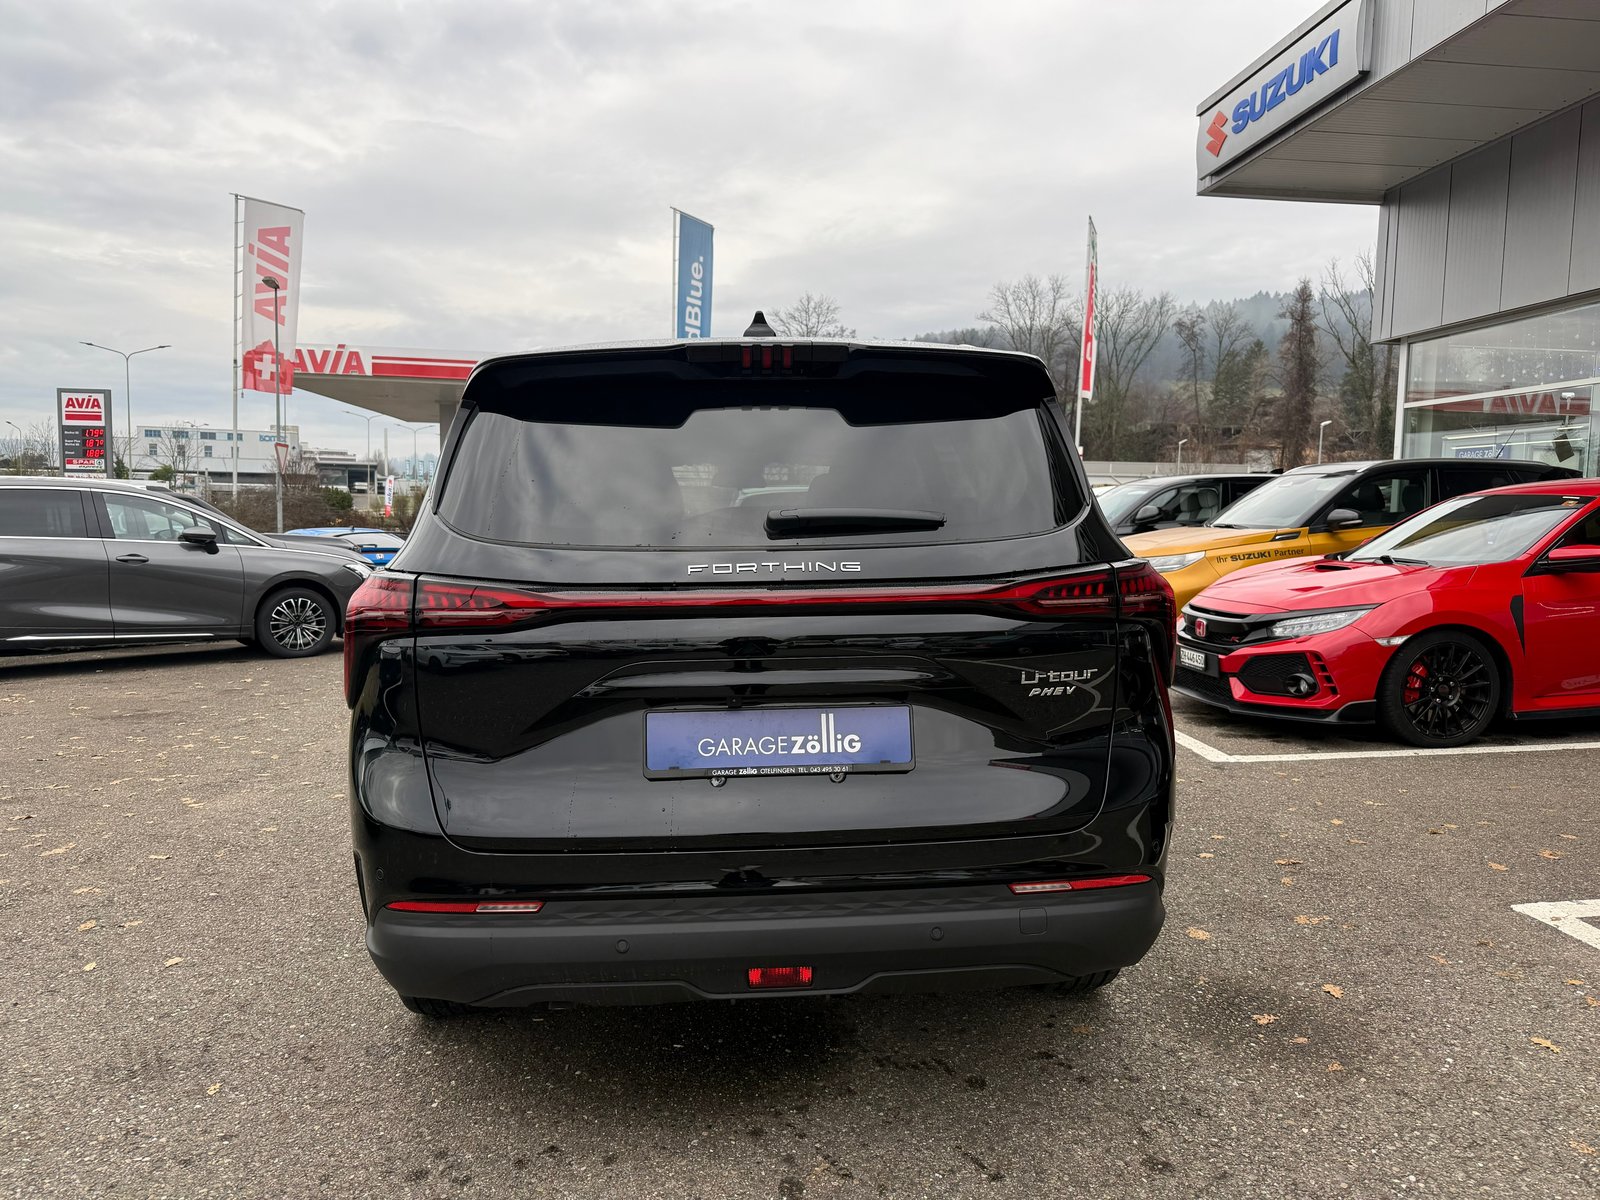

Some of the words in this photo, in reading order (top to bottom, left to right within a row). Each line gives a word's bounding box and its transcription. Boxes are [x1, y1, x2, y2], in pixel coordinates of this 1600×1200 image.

[1231, 28, 1340, 135] SUZUKI
[1216, 556, 1228, 564] Ihr
[1230, 550, 1271, 562] SUZUKI
[1273, 548, 1304, 557] Partner
[687, 561, 861, 575] FORTHING
[1029, 685, 1077, 697] PHEV
[698, 736, 788, 756] GARAGE
[760, 767, 795, 775] OTELFINGEN
